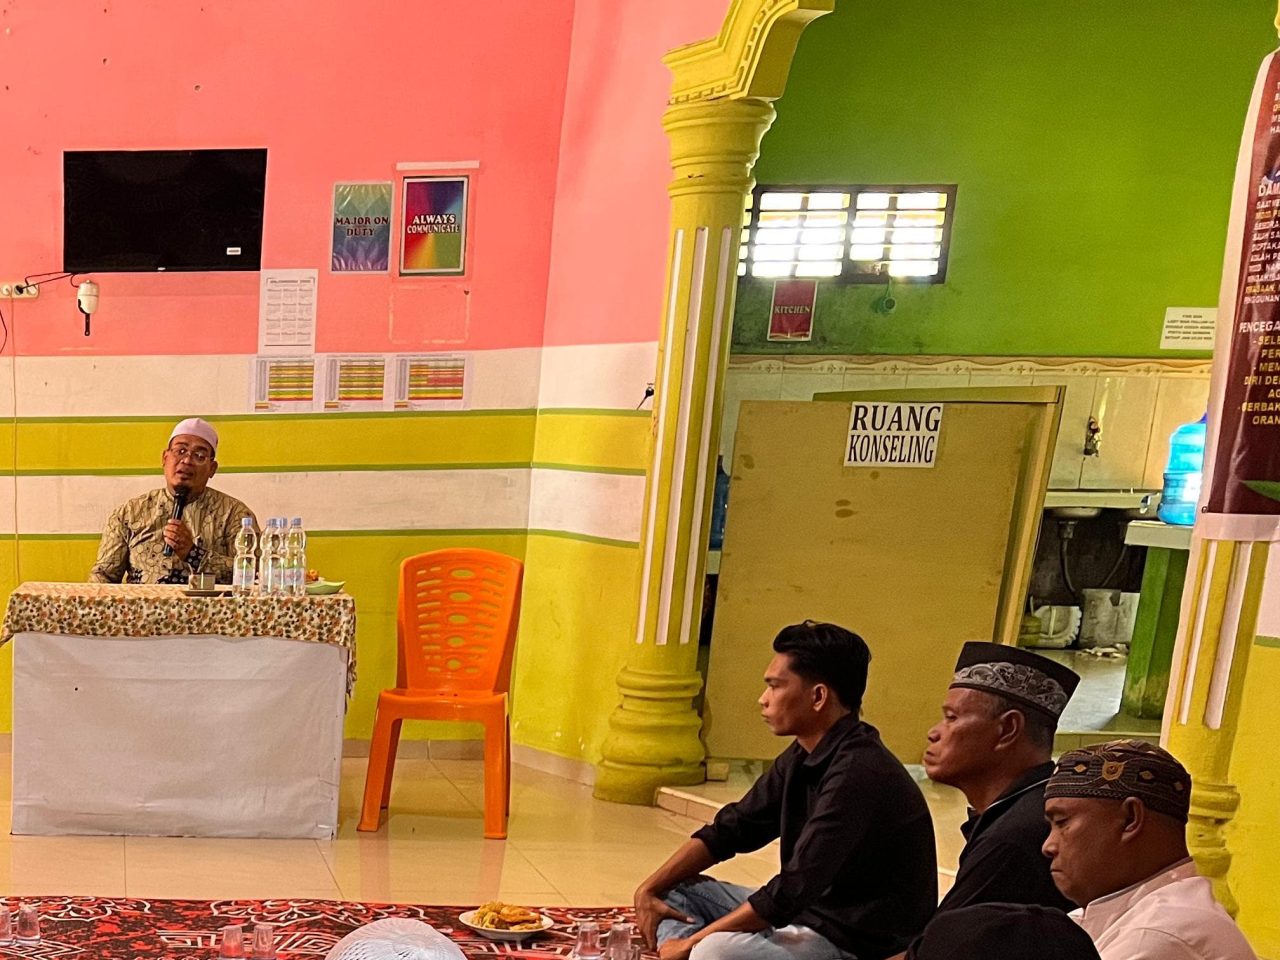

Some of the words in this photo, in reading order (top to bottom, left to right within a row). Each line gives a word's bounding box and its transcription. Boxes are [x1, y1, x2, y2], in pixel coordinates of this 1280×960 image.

[335, 216, 371, 226] MAJOR
[373, 216, 389, 225] ON
[412, 214, 456, 225] ALWAYS
[346, 228, 375, 237] DUTY
[407, 224, 460, 234] COMMUNICATE
[774, 305, 810, 315] KITCHEN
[851, 404, 941, 433] RUANG
[847, 434, 935, 464] KONSELING
